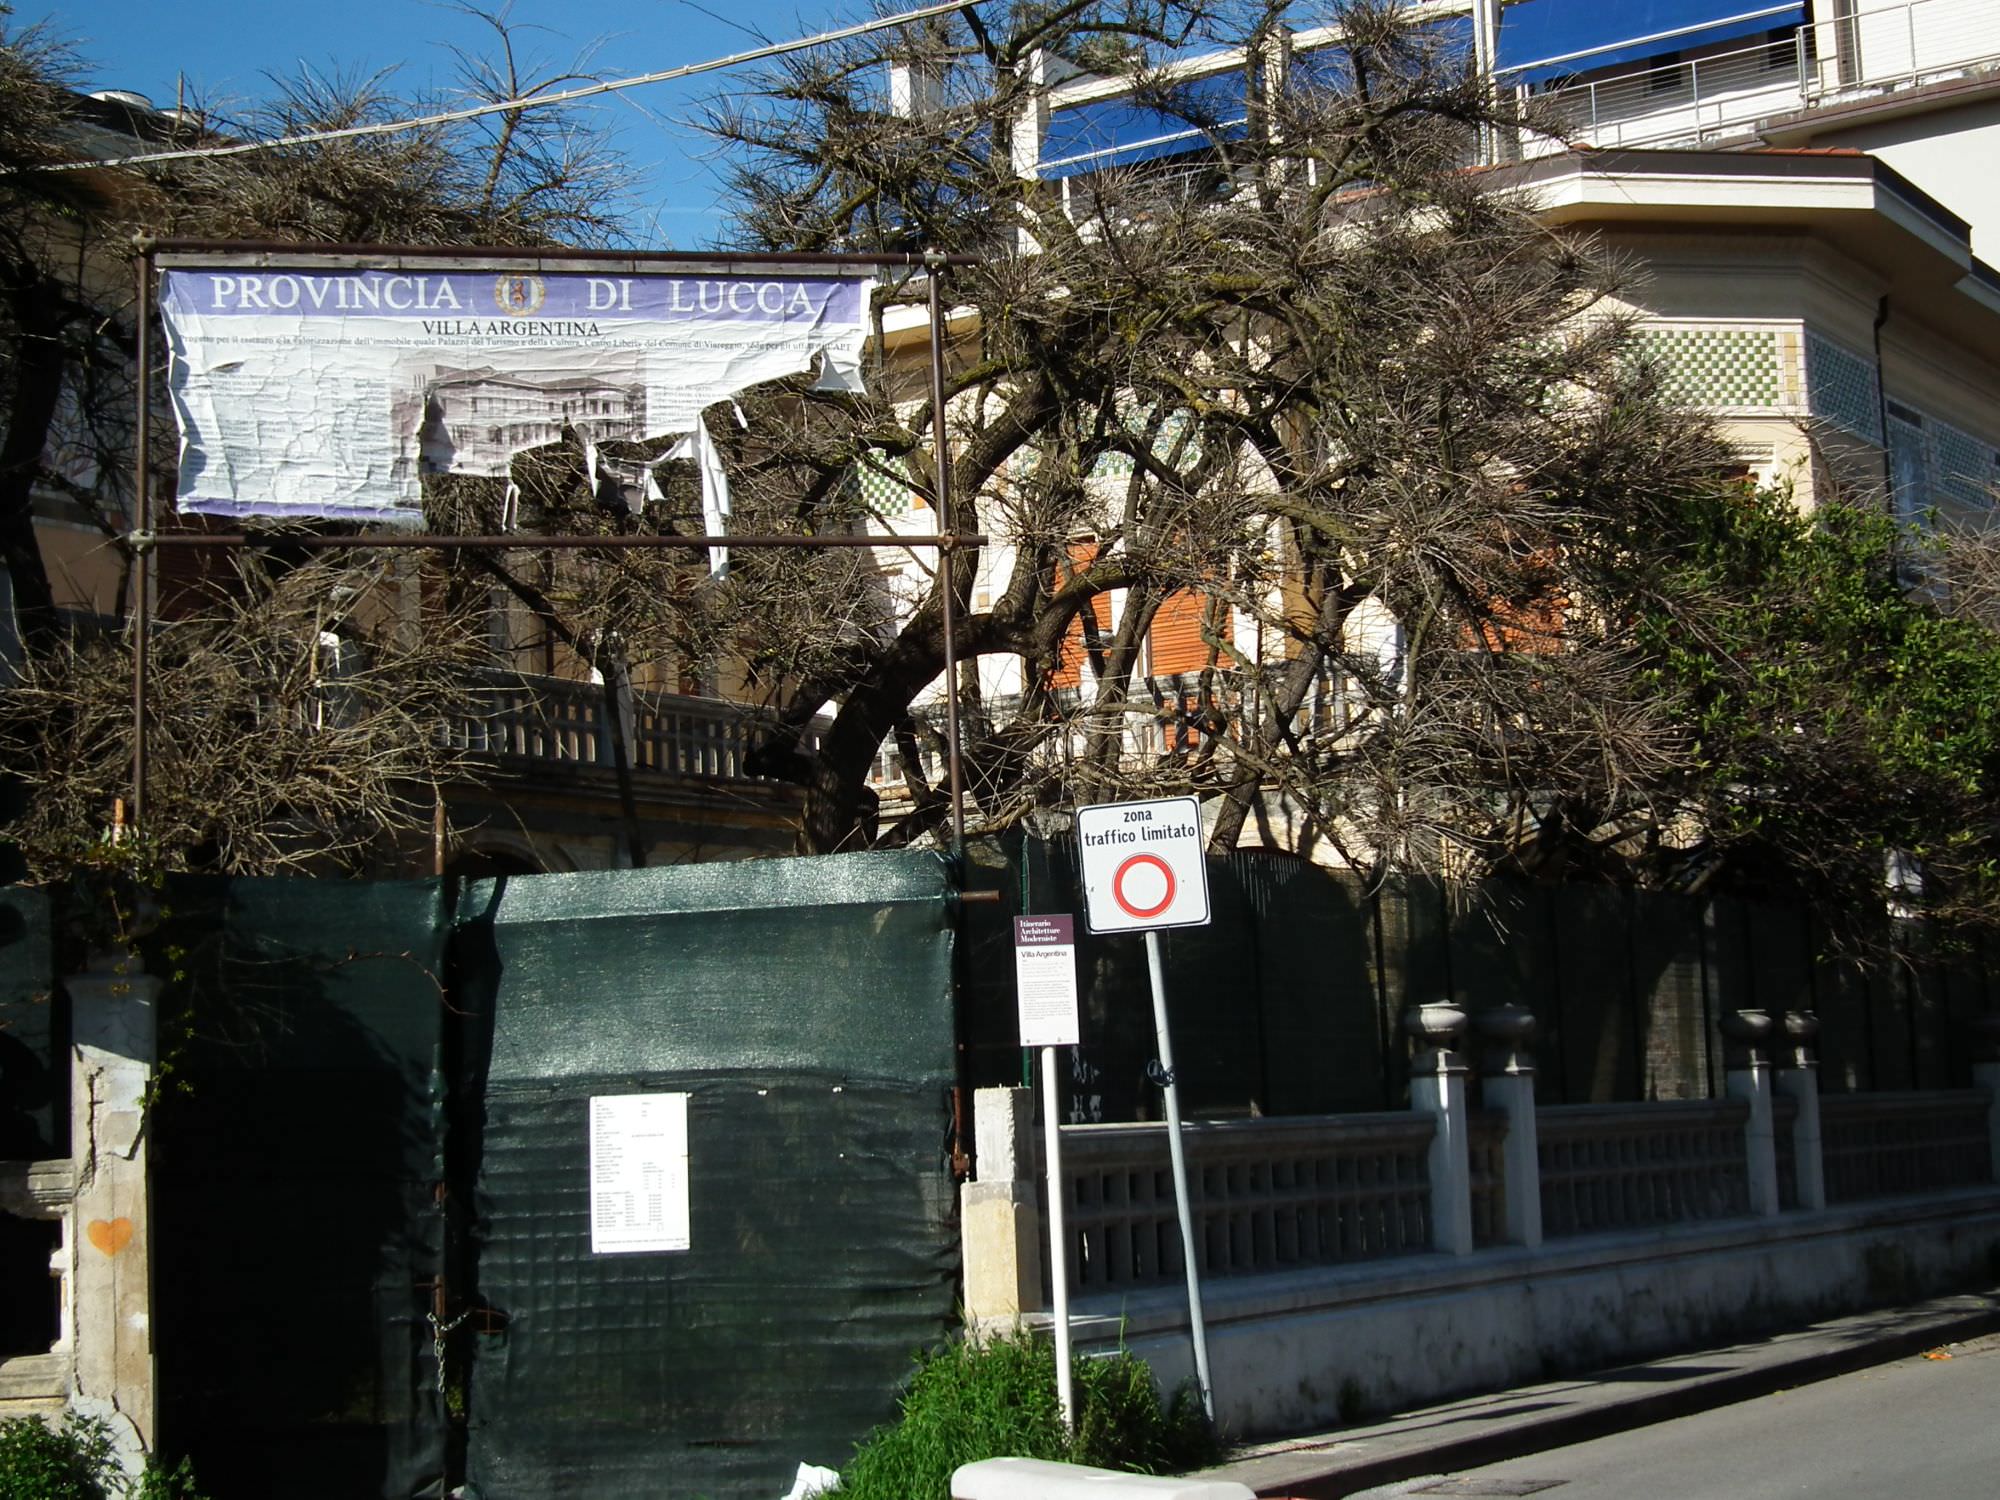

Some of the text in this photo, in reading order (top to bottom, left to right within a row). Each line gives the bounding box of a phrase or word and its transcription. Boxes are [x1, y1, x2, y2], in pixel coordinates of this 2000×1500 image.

[209, 276, 819, 315] PROVINCIA DI LUCCA
[422, 320, 601, 337] VILLA ARGENTINA
[413, 337, 436, 346] quale
[438, 336, 468, 346] Palazzo
[528, 337, 548, 347] della
[1123, 809, 1153, 823] zona
[1085, 823, 1196, 847] traffico limitato
[1019, 919, 1052, 928] Itinerario
[1021, 927, 1061, 935] Architetture
[1021, 935, 1058, 943] Moderniste
[1036, 950, 1068, 959] Argentina
